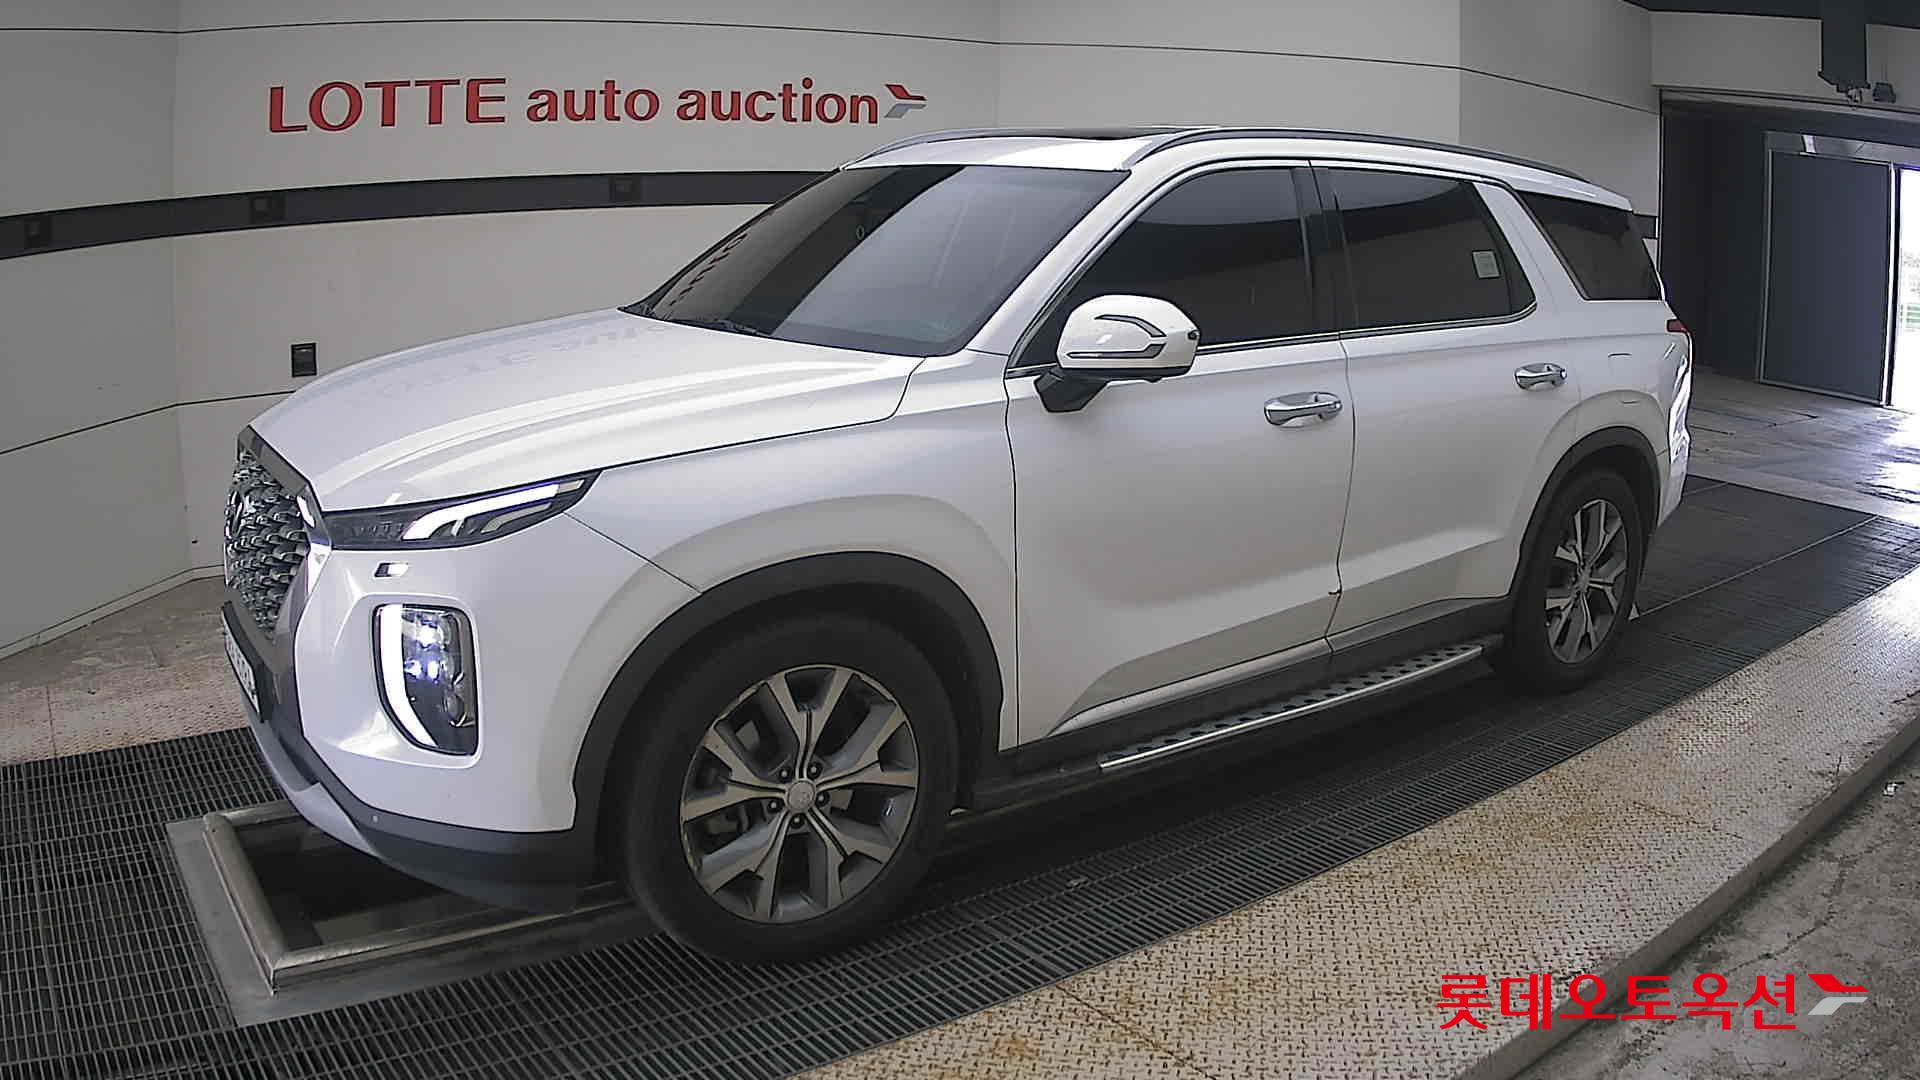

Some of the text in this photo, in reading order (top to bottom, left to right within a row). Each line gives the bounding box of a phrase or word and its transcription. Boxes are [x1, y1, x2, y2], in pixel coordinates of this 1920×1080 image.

[269, 78, 879, 133] LOTTE auto auction
